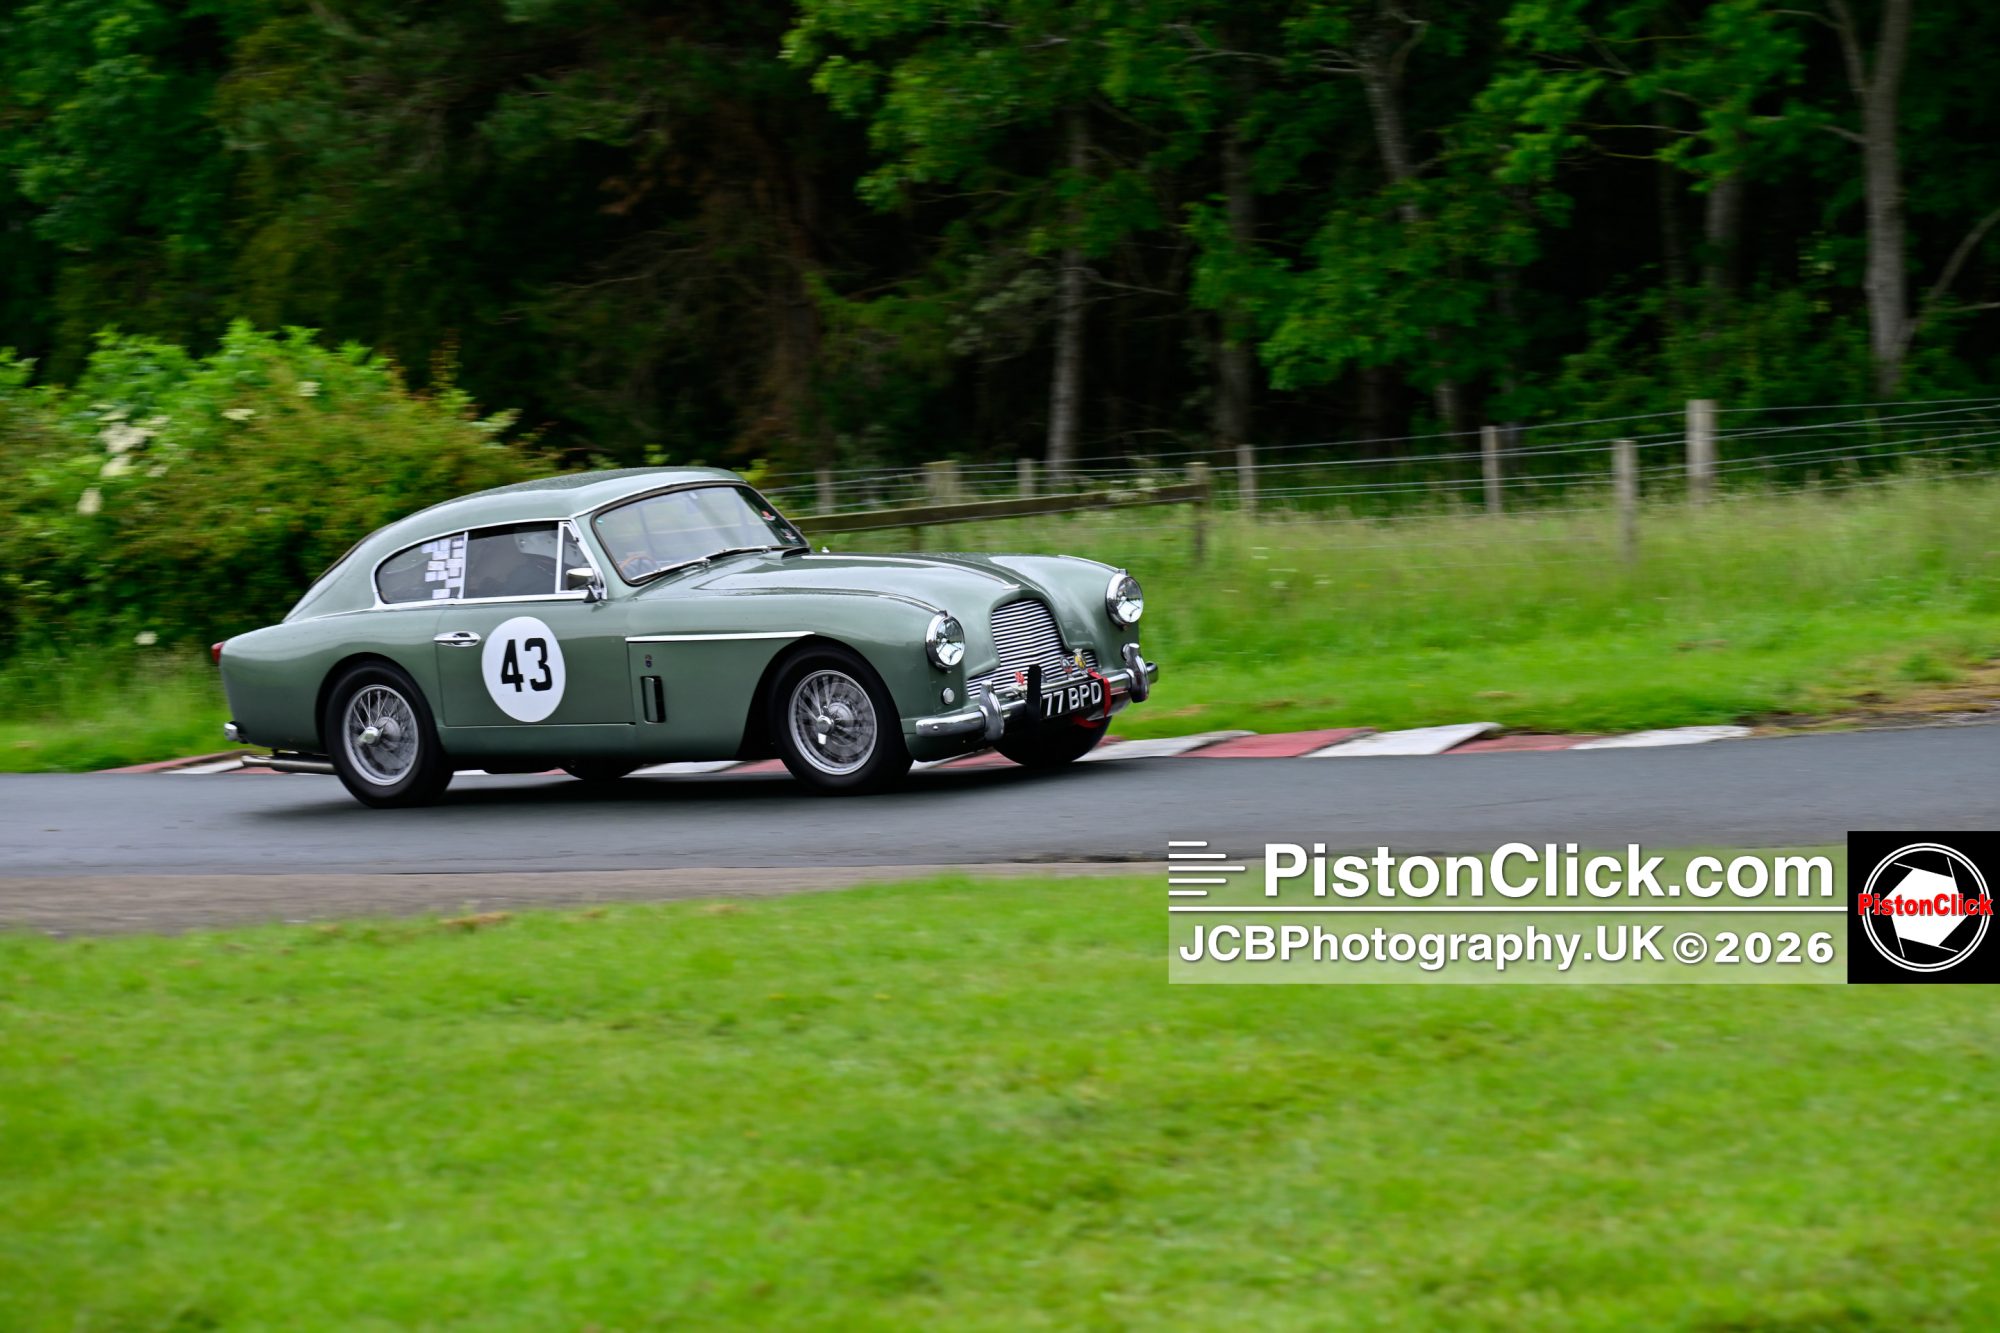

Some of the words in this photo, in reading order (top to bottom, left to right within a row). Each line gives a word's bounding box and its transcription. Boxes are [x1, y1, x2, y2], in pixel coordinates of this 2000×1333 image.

[501, 638, 553, 692] 43
[1042, 690, 1064, 717] 77
[1068, 682, 1102, 710] BPD
